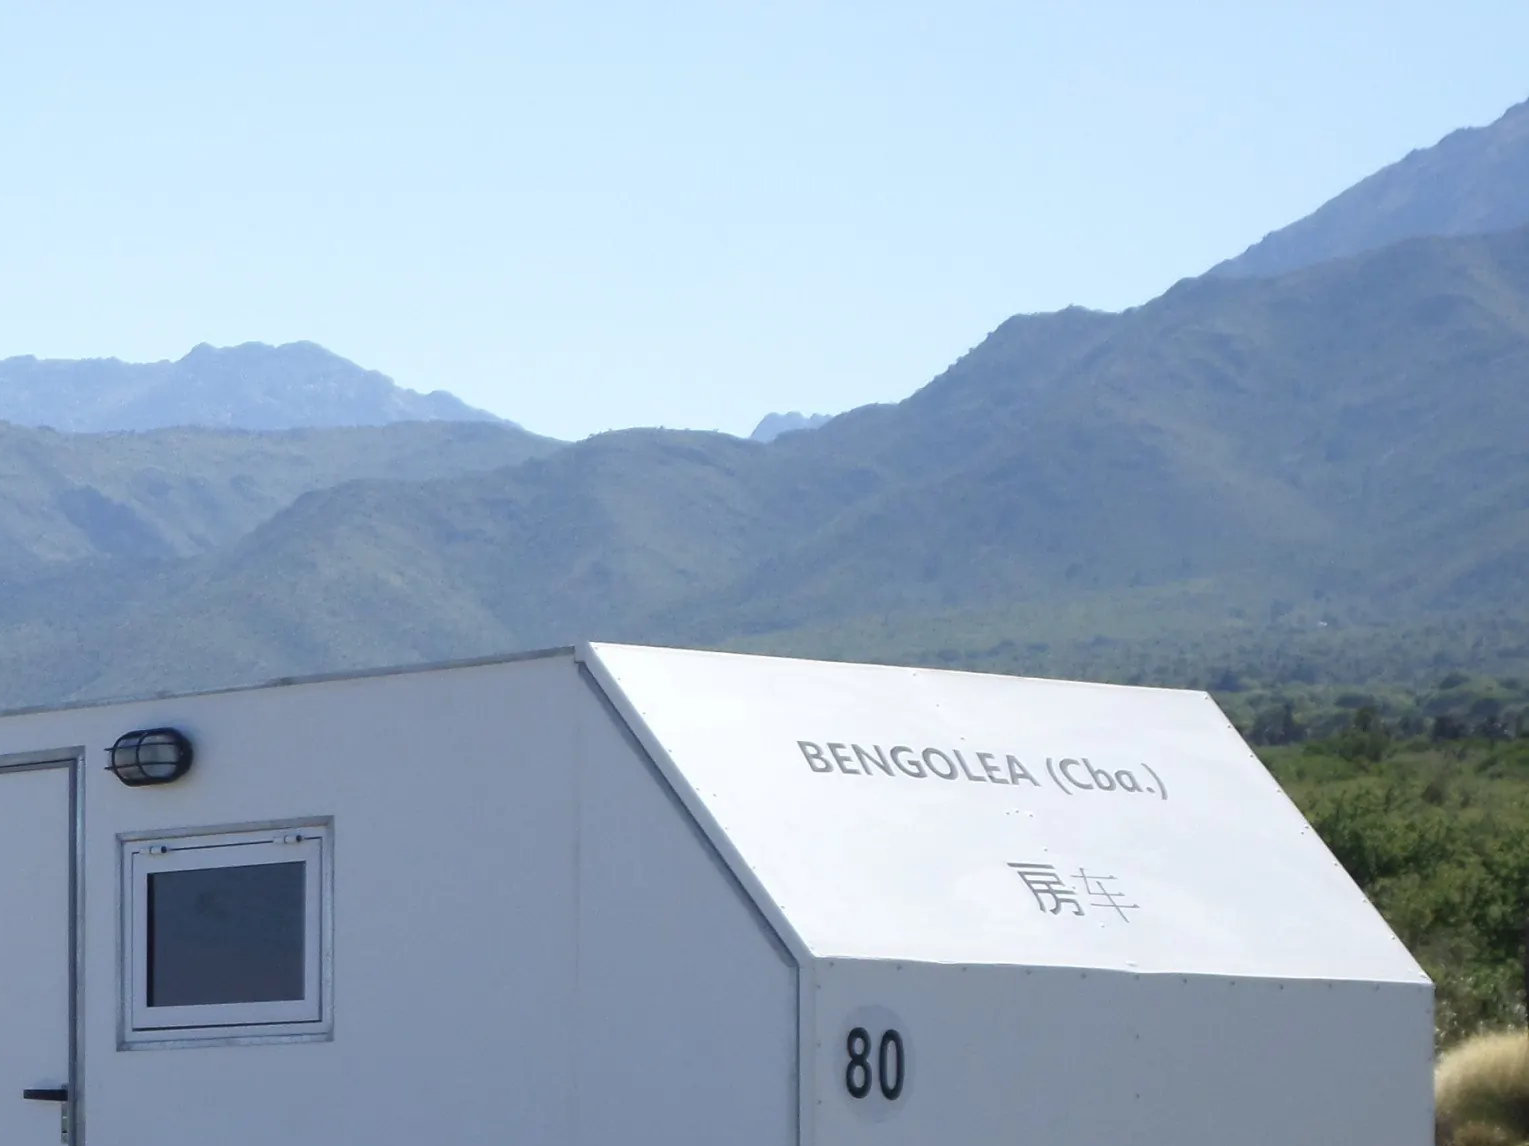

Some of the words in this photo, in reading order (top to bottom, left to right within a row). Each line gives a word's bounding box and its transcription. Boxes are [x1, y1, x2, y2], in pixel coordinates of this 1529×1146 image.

[797, 740, 1040, 787] BENGOLEA
[1046, 758, 1168, 800] (Cba.)
[1006, 862, 1140, 923] 房车
[846, 1026, 905, 1100] 80
